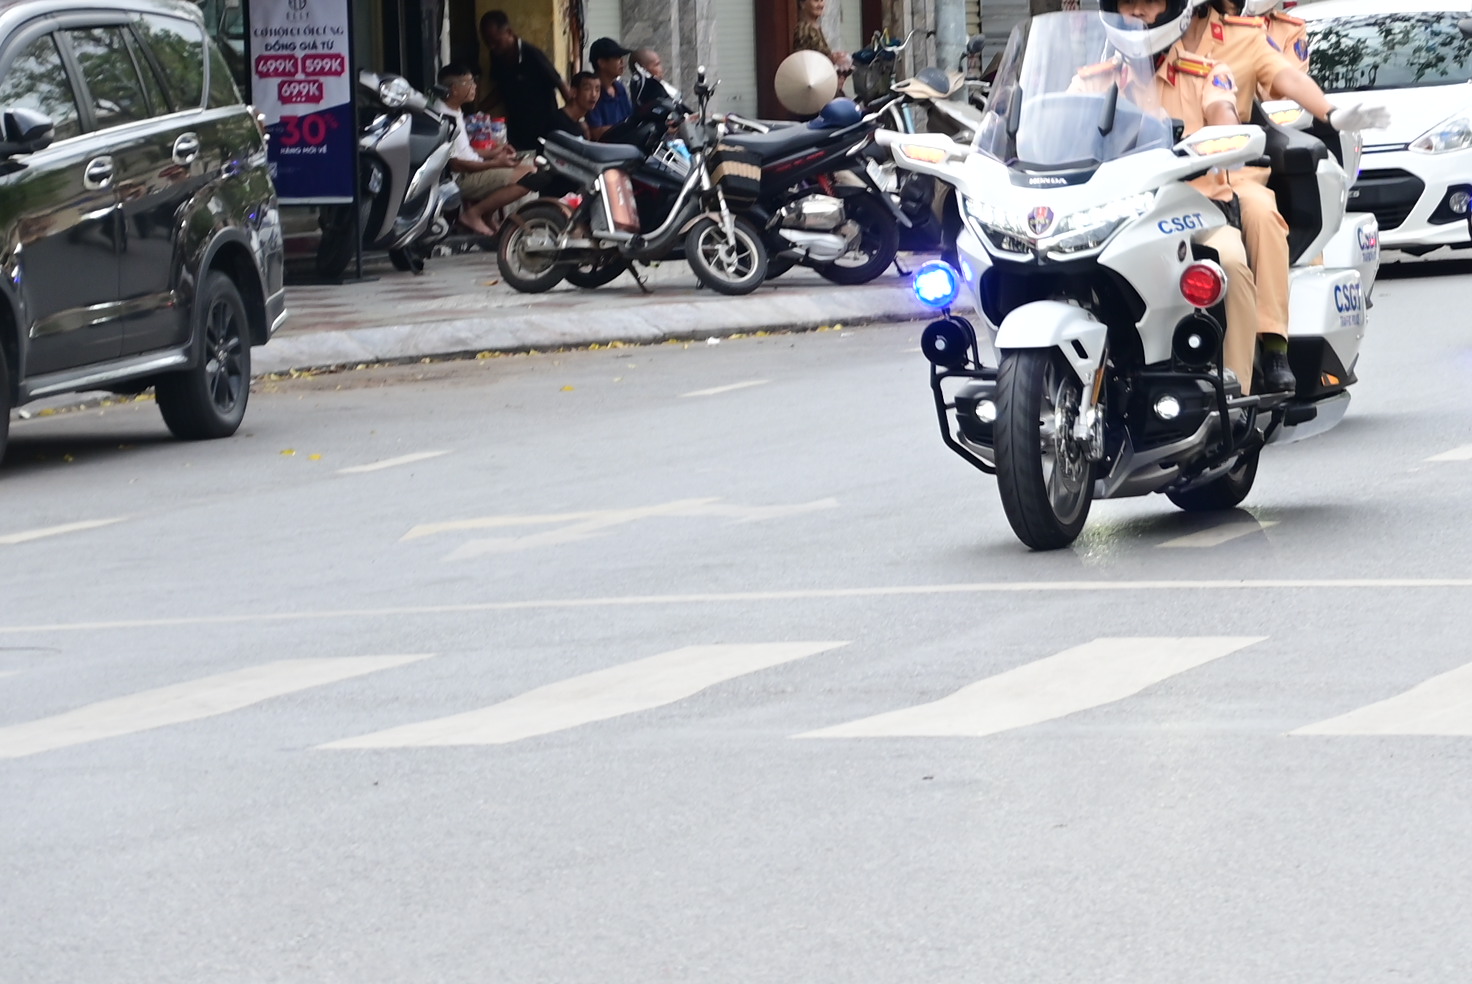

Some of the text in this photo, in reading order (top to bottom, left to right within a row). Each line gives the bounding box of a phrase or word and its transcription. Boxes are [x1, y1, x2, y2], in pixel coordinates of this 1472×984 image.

[258, 58, 341, 73] 499K 599K
[281, 82, 320, 97] 699K
